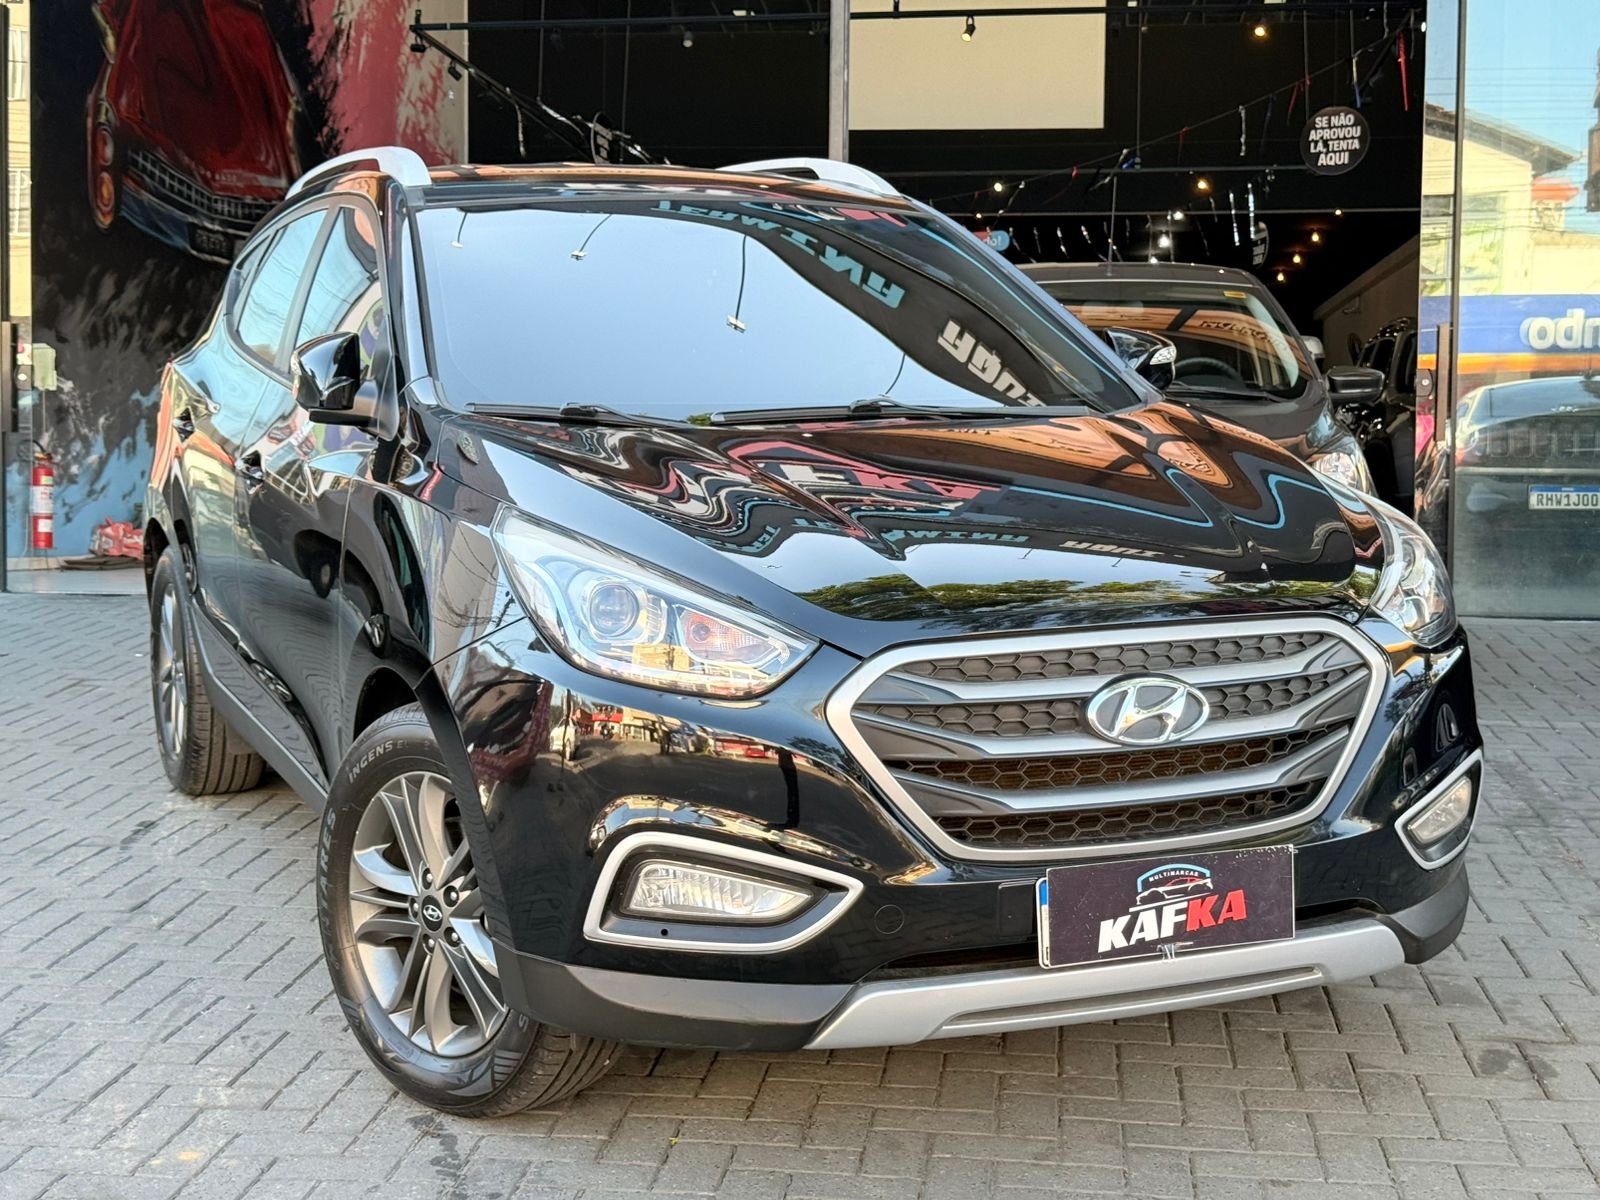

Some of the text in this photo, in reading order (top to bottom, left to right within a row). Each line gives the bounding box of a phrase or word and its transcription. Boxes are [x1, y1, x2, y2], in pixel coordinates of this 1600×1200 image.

[1315, 112, 1355, 128] SE NÃO
[1308, 126, 1361, 141] APROVOU
[1327, 138, 1360, 151] TENTA
[1317, 151, 1350, 166] AQUI
[1536, 494, 1599, 506] RHW1J00
[348, 741, 393, 784] INGENS
[1148, 870, 1199, 882] MULTIMARCAS
[1097, 889, 1248, 953] KAFKA
